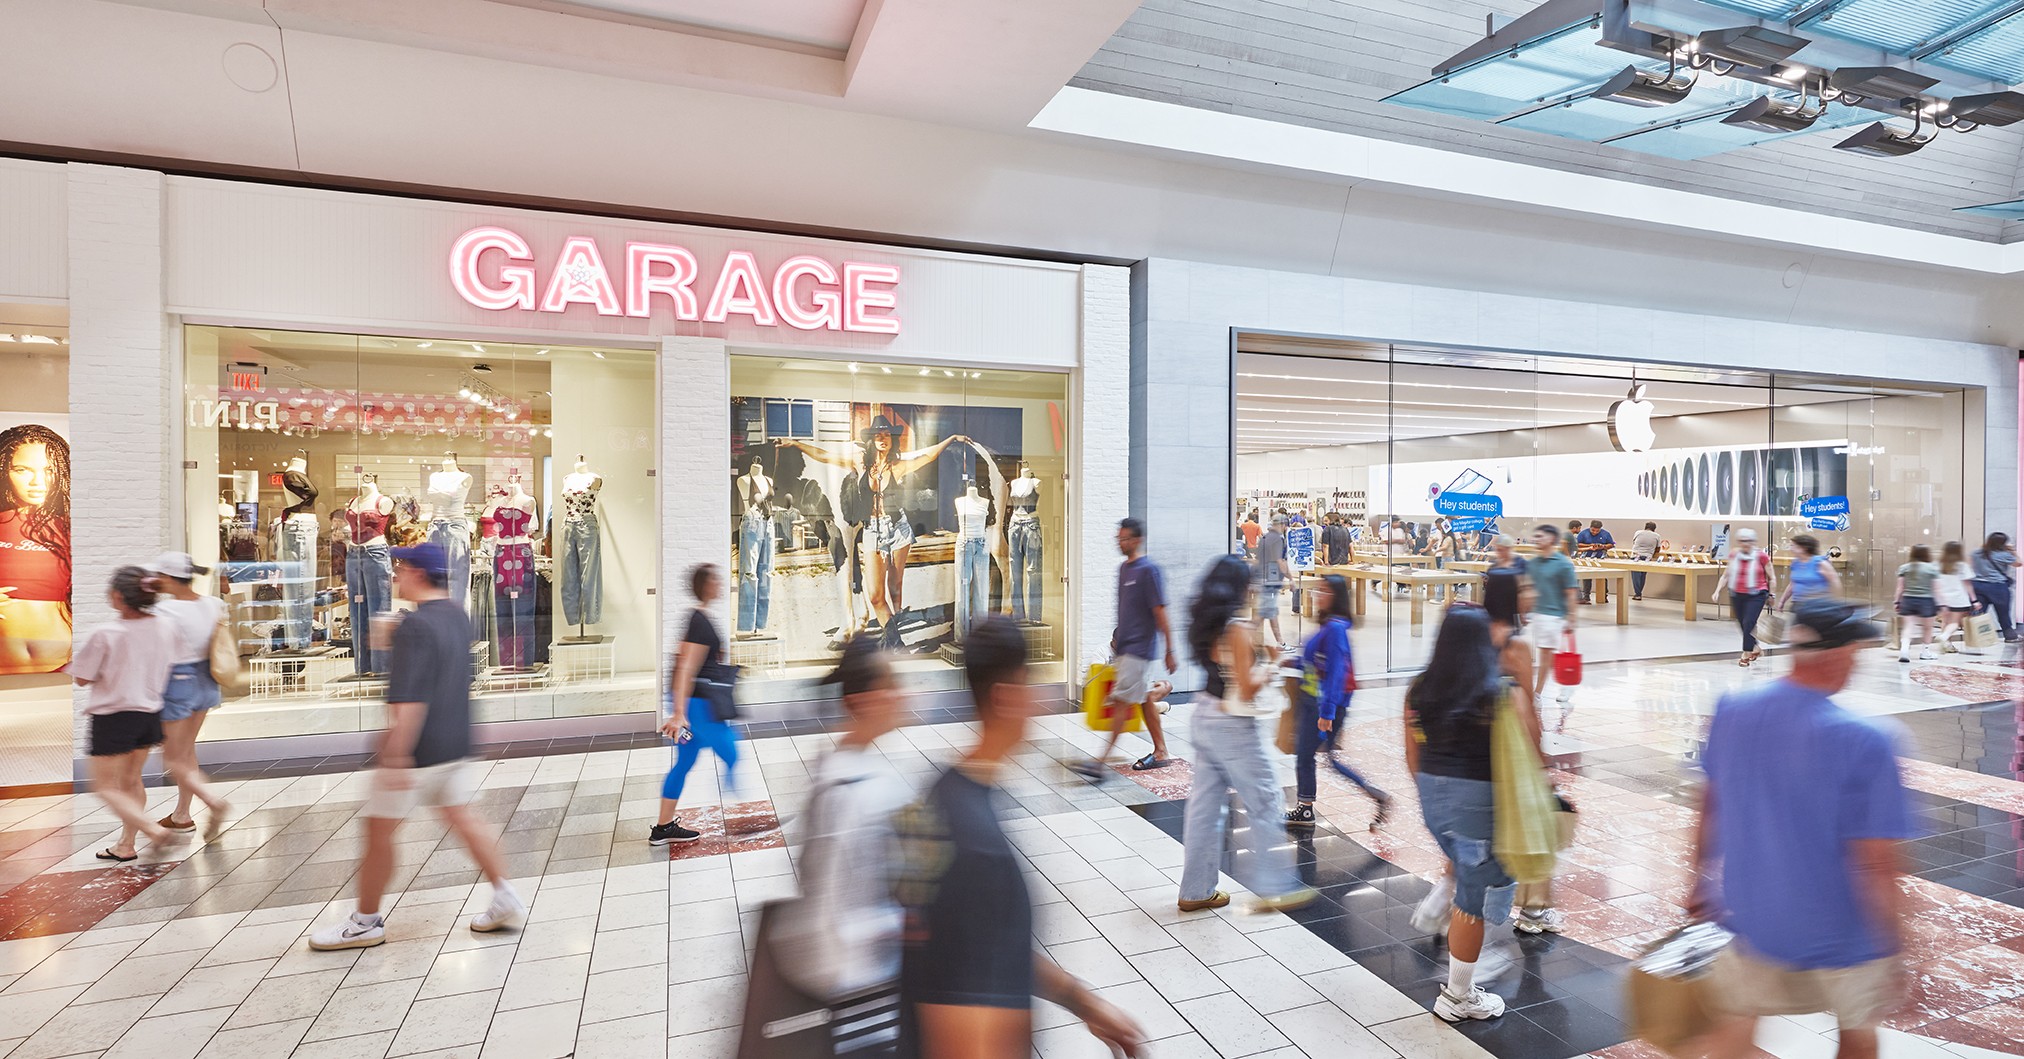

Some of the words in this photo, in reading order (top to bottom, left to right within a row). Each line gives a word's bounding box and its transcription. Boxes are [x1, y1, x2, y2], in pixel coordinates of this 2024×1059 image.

[449, 226, 901, 335] GARAGE
[1440, 499, 1457, 511] Hey
[1458, 501, 1498, 512] students!
[1804, 504, 1817, 514] Hey
